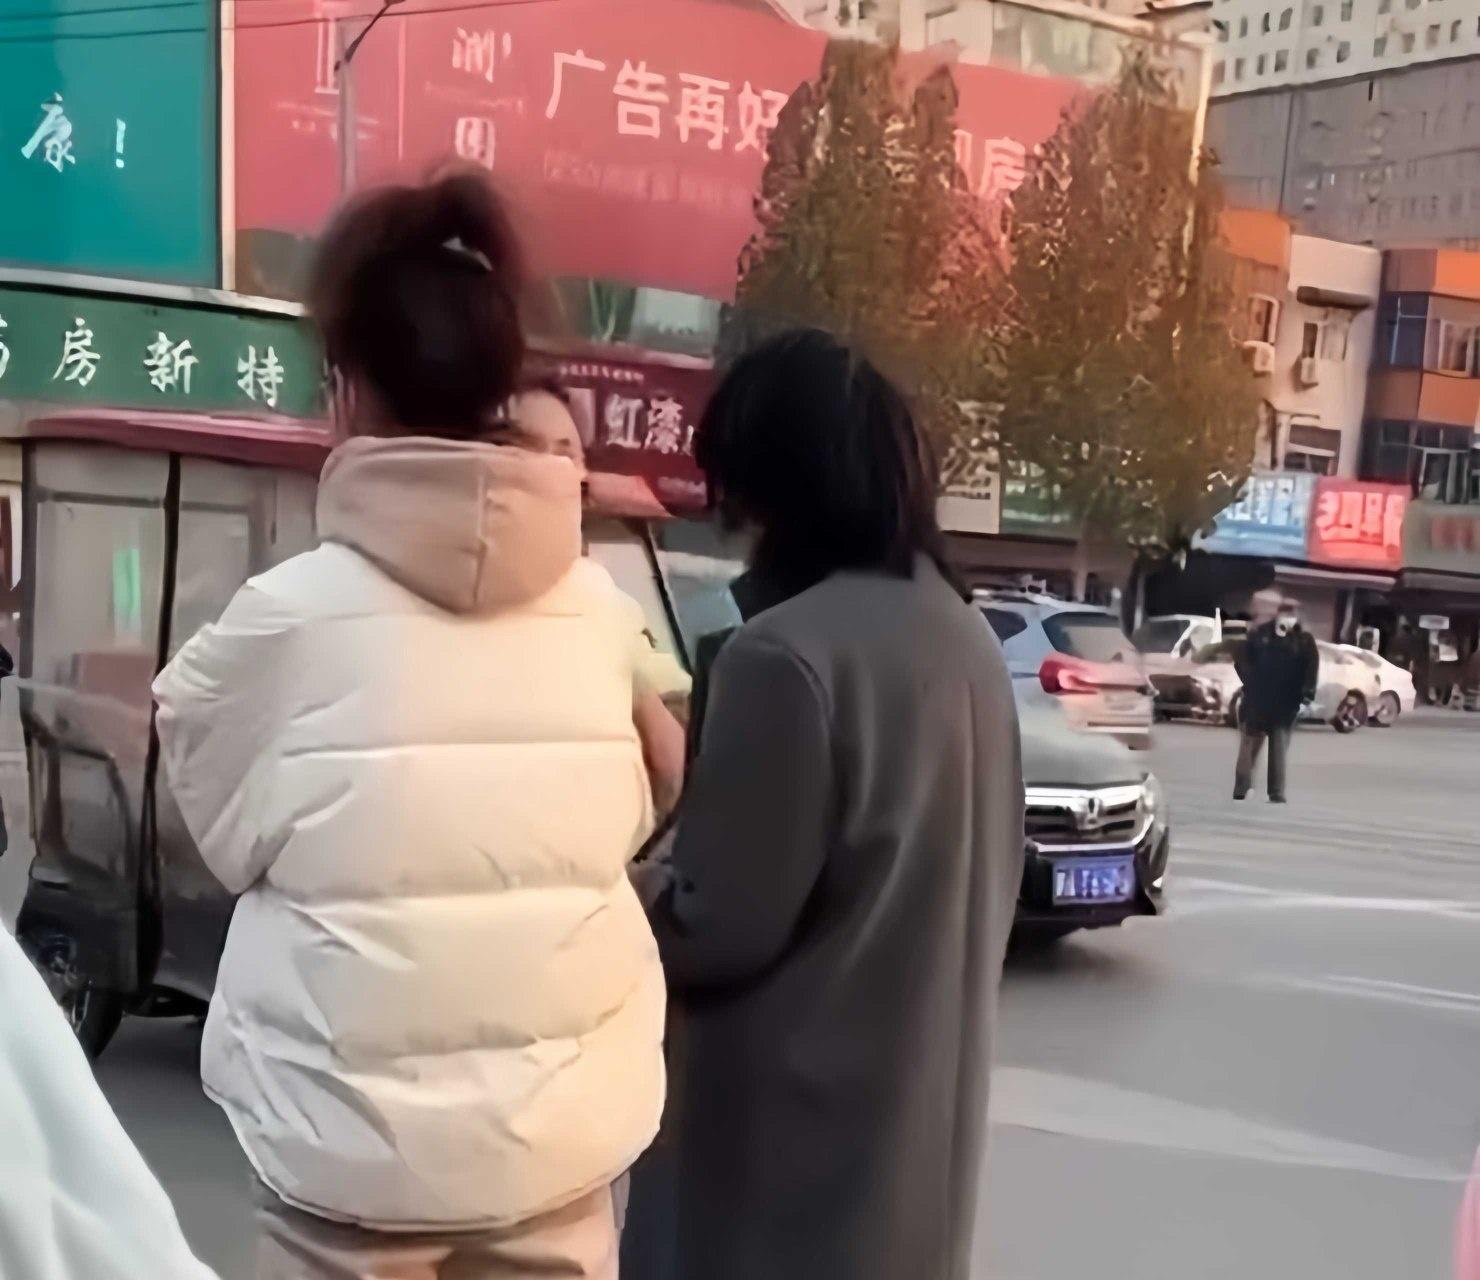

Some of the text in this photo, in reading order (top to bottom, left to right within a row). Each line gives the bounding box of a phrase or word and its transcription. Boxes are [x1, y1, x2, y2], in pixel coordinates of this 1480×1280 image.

[545, 49, 791, 161] 广告再好
[0, 316, 285, 409] 房新特
